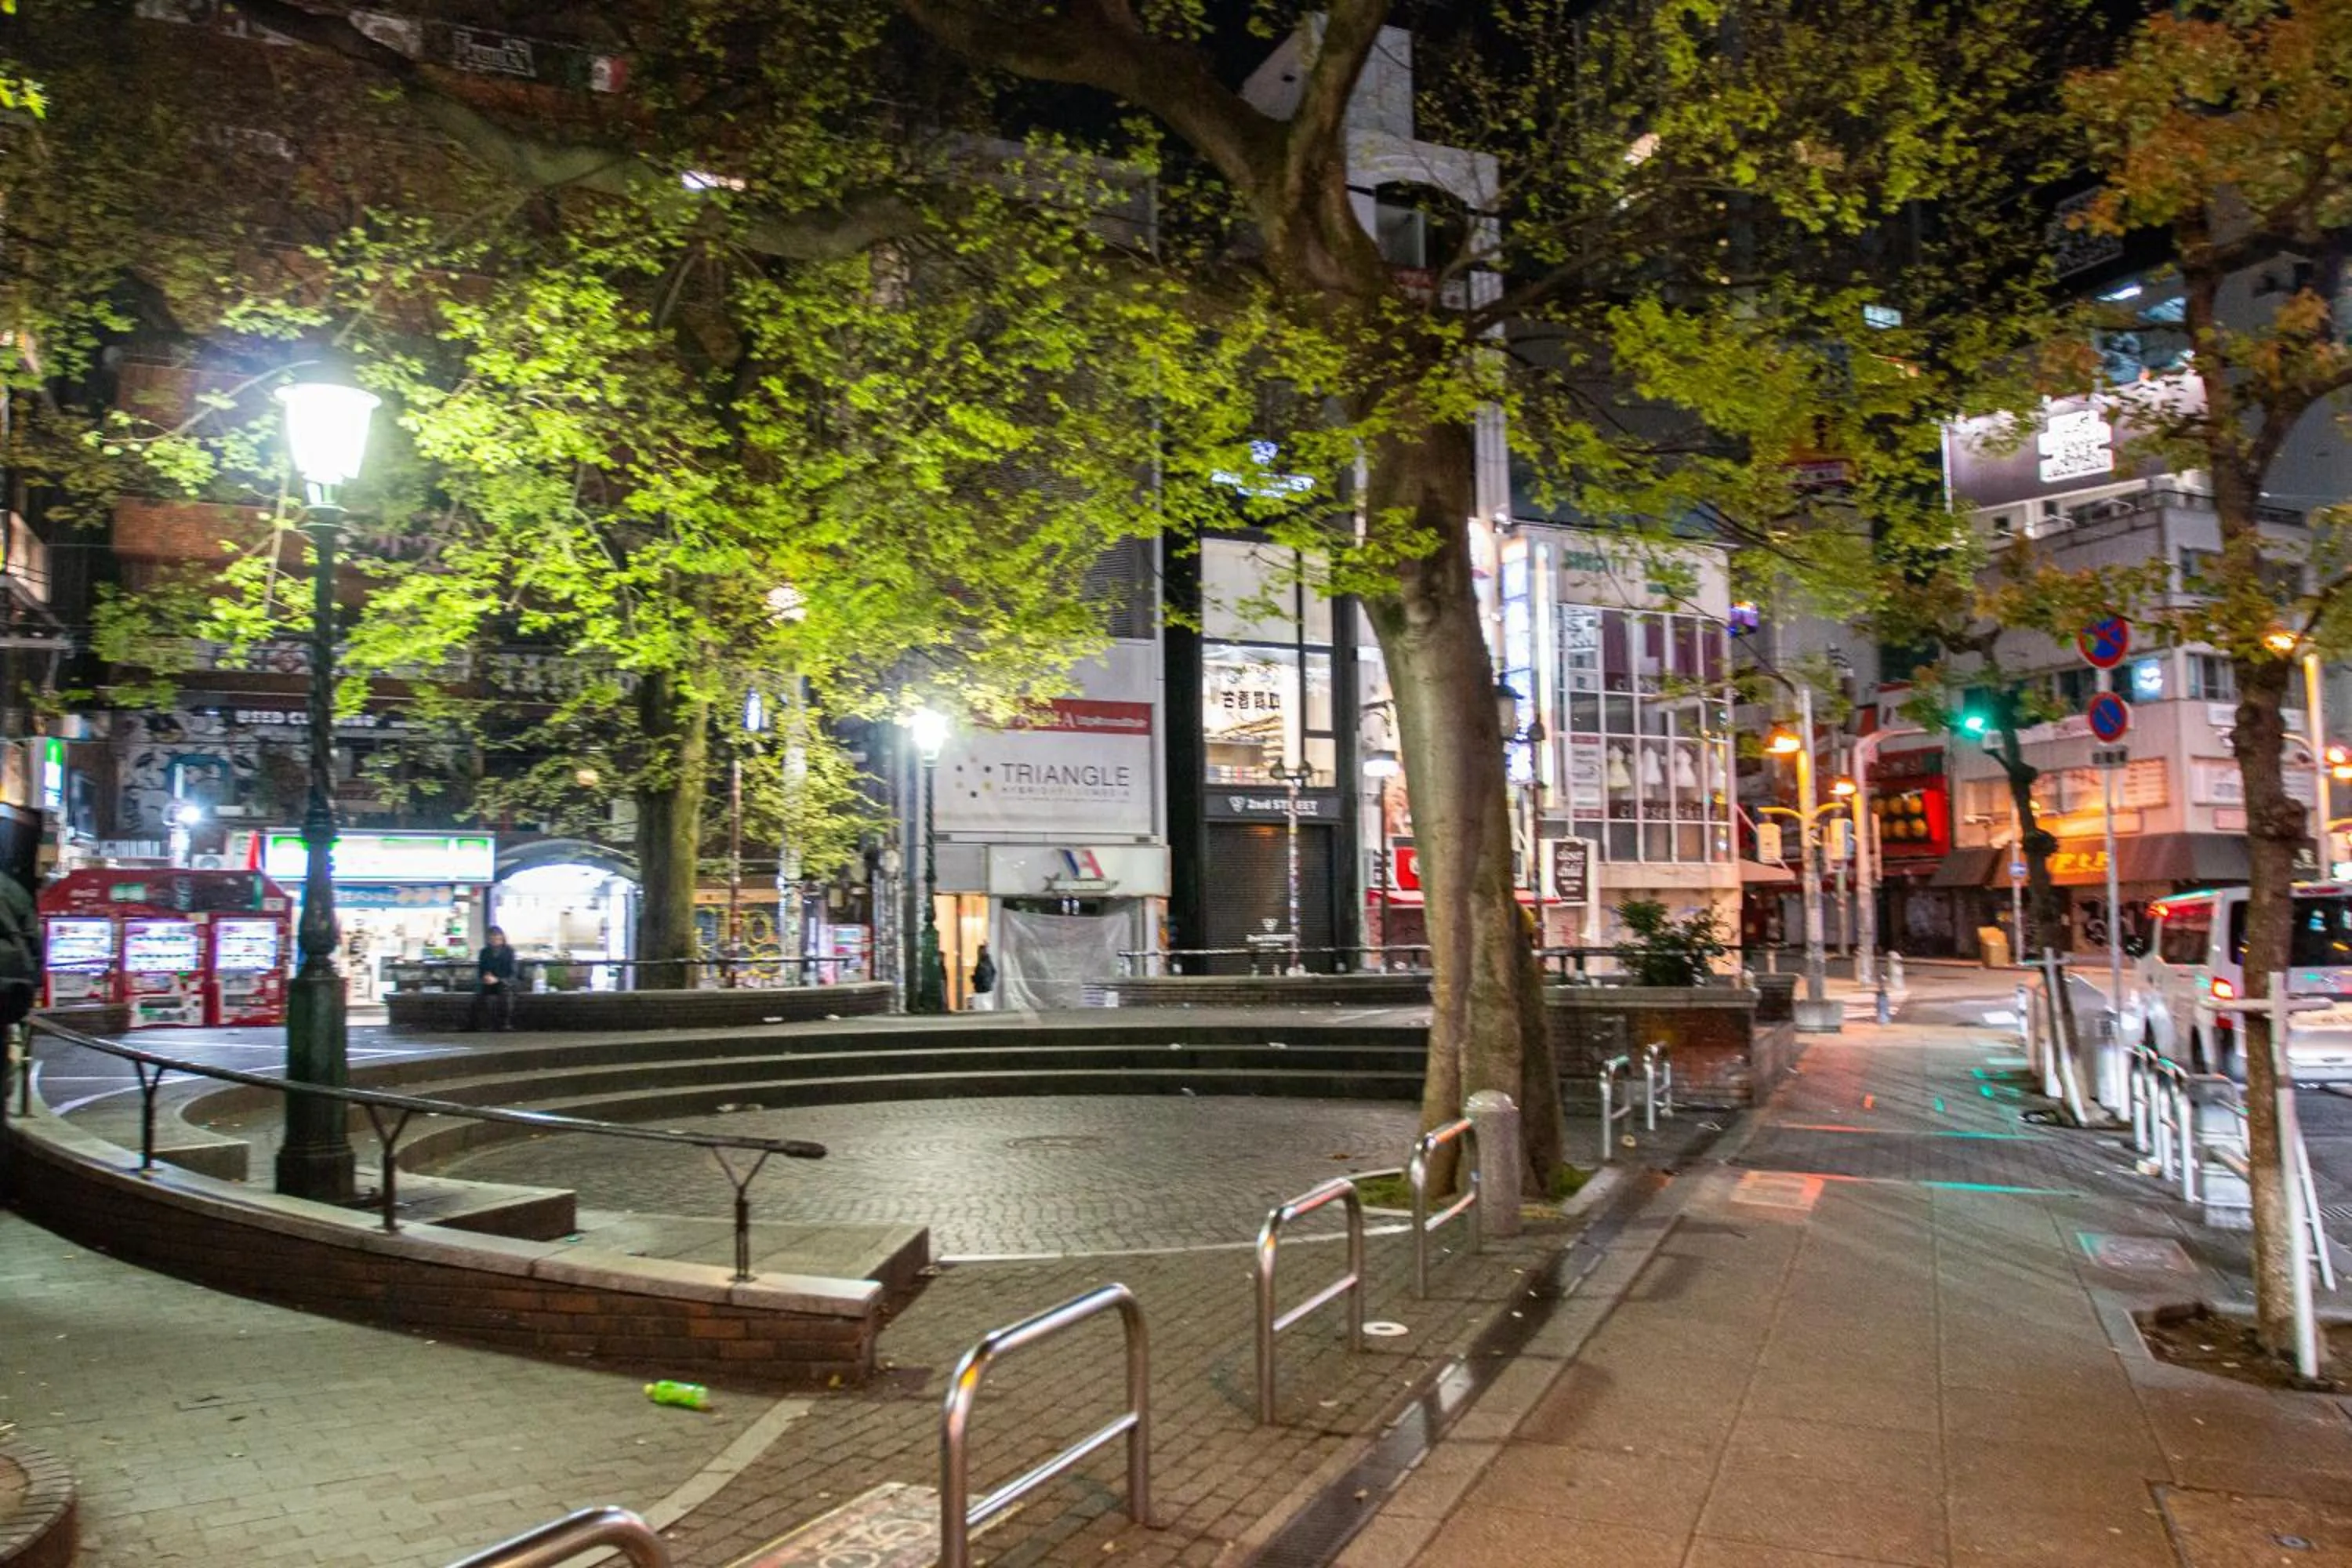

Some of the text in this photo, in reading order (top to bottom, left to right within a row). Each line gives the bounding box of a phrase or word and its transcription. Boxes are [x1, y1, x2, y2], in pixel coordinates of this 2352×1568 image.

[1000, 763, 1130, 787] TRIANGLE
[1247, 798, 1318, 811] 2nd STEET
